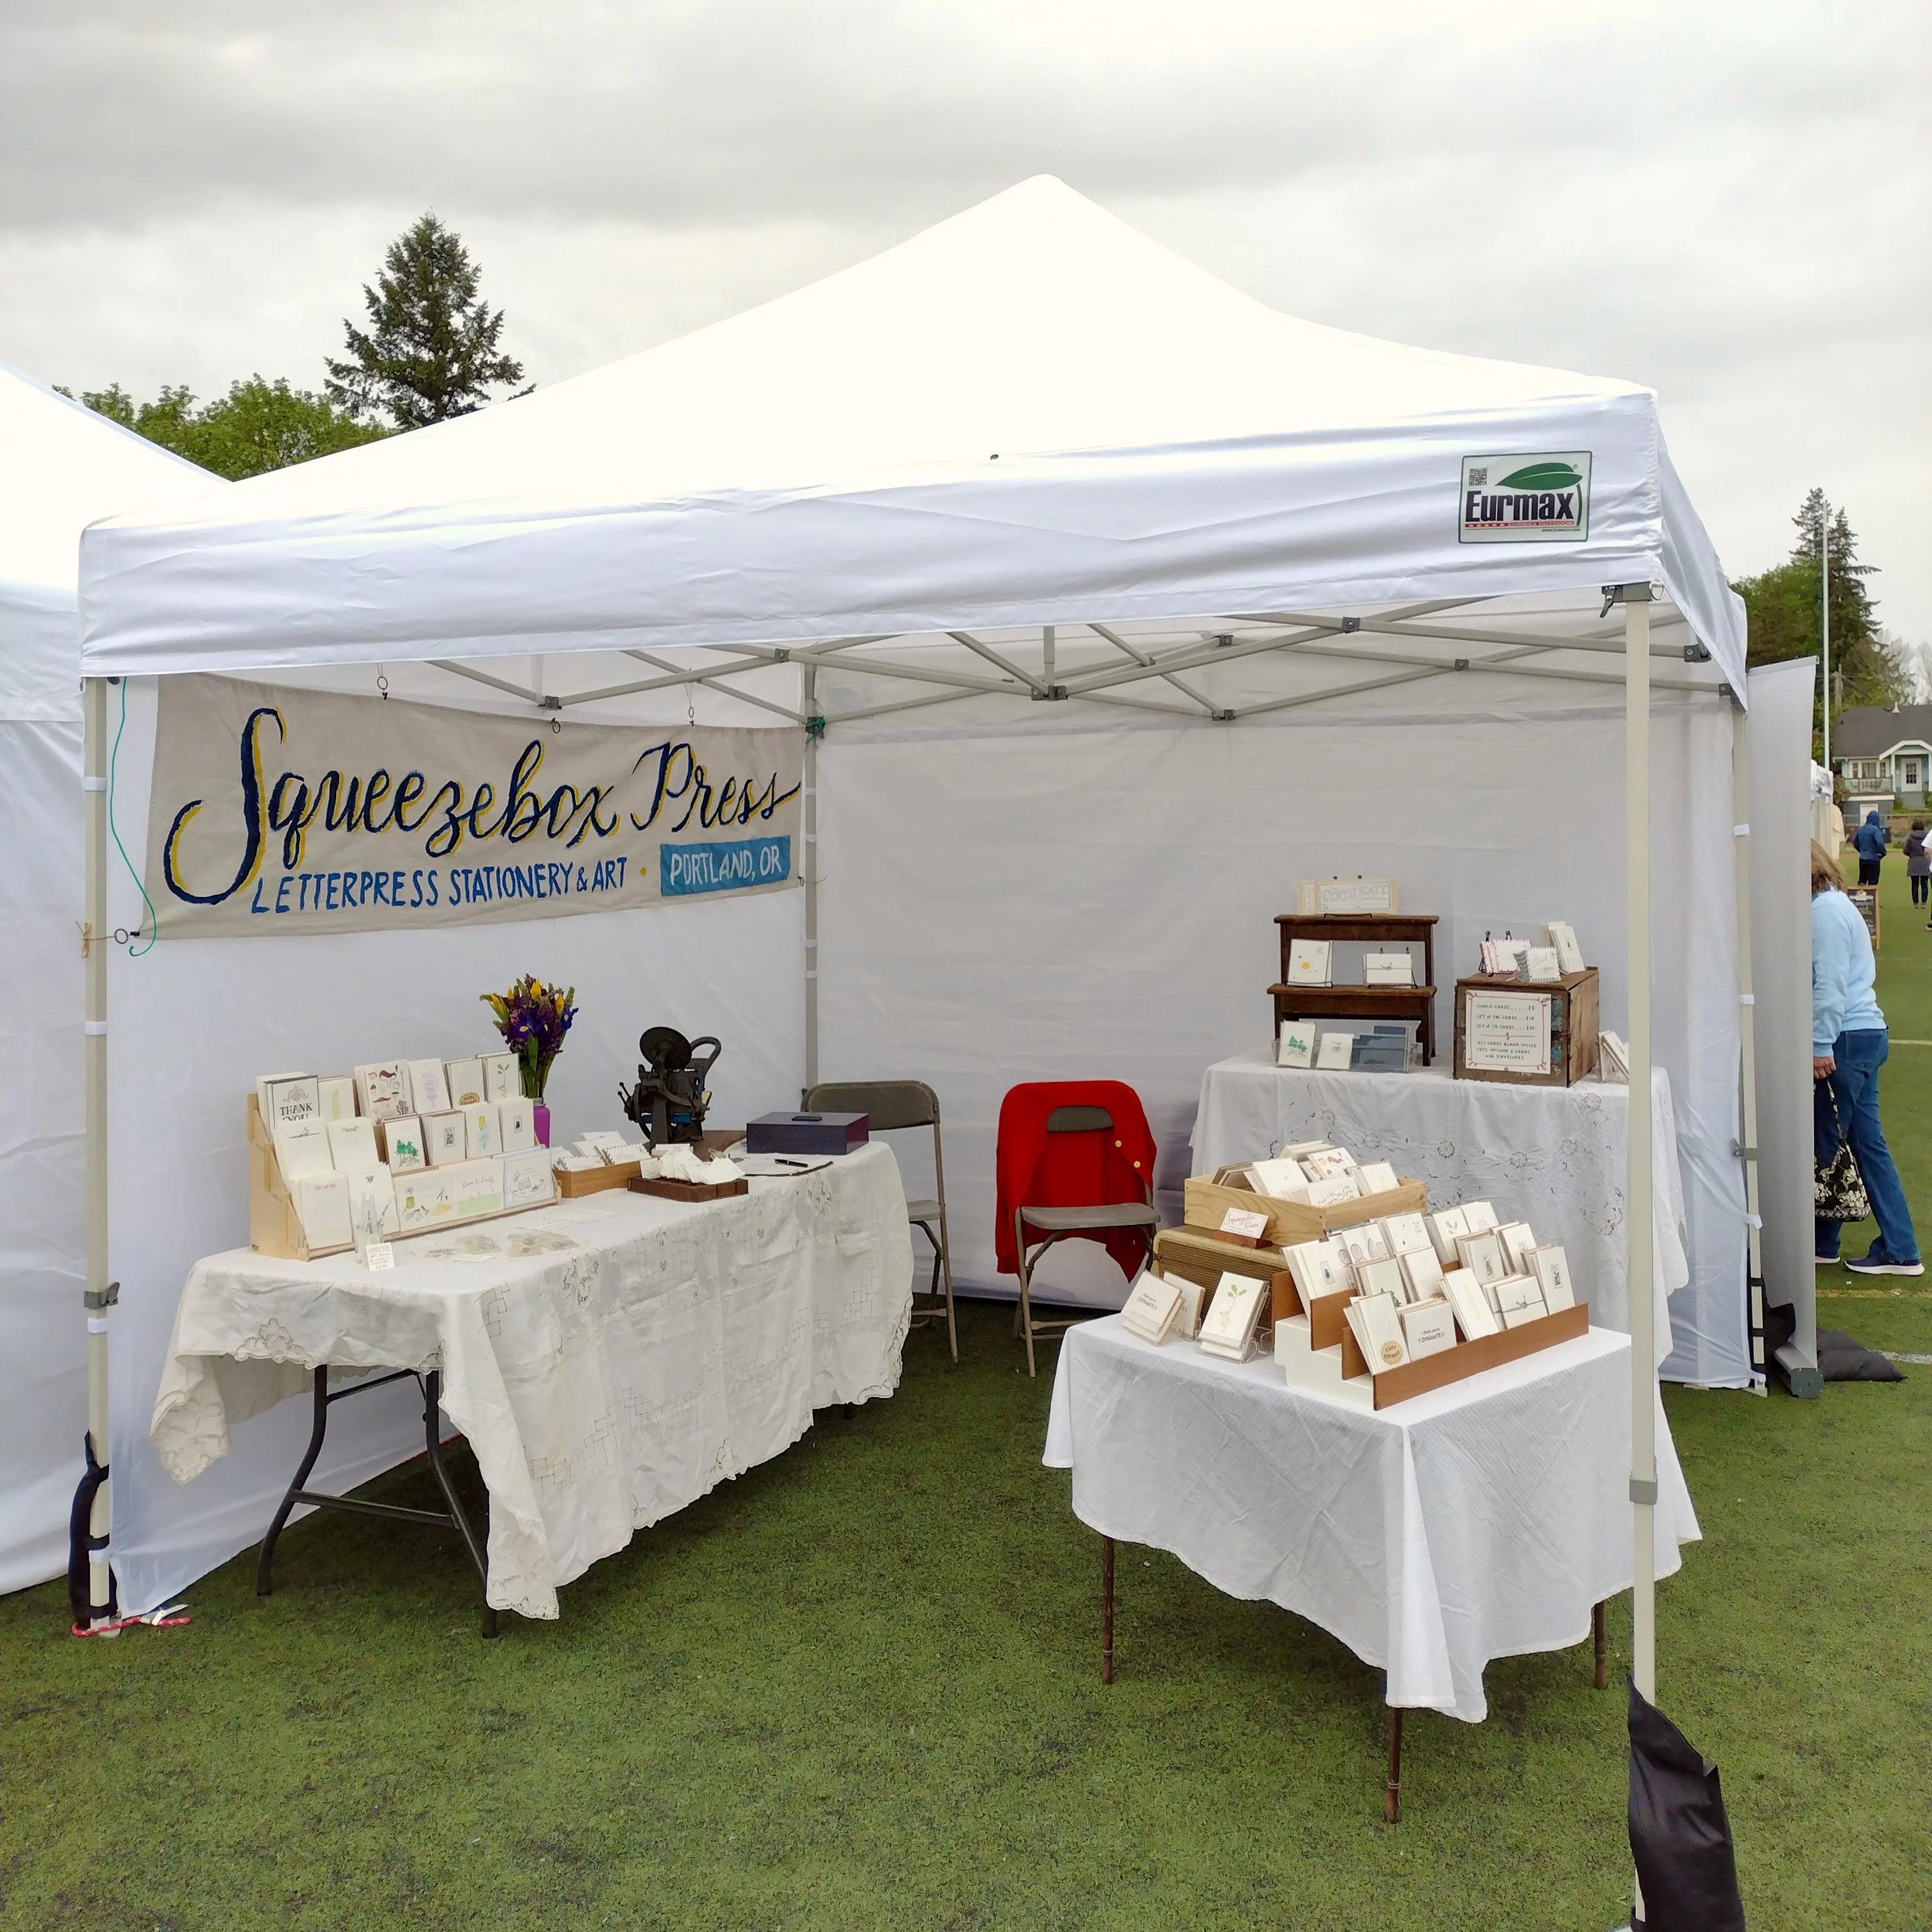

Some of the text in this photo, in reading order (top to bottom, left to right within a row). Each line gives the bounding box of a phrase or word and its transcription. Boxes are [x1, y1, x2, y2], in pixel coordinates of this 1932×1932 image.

[1465, 490, 1574, 522] Eurmax
[164, 707, 801, 905] Squeezebox Press
[251, 866, 439, 914] LETTERPRESS
[449, 862, 573, 906] STATIONERY
[591, 857, 628, 890] ART
[670, 845, 782, 886] PORTLAND, OR
[279, 1102, 313, 1115] THANK
